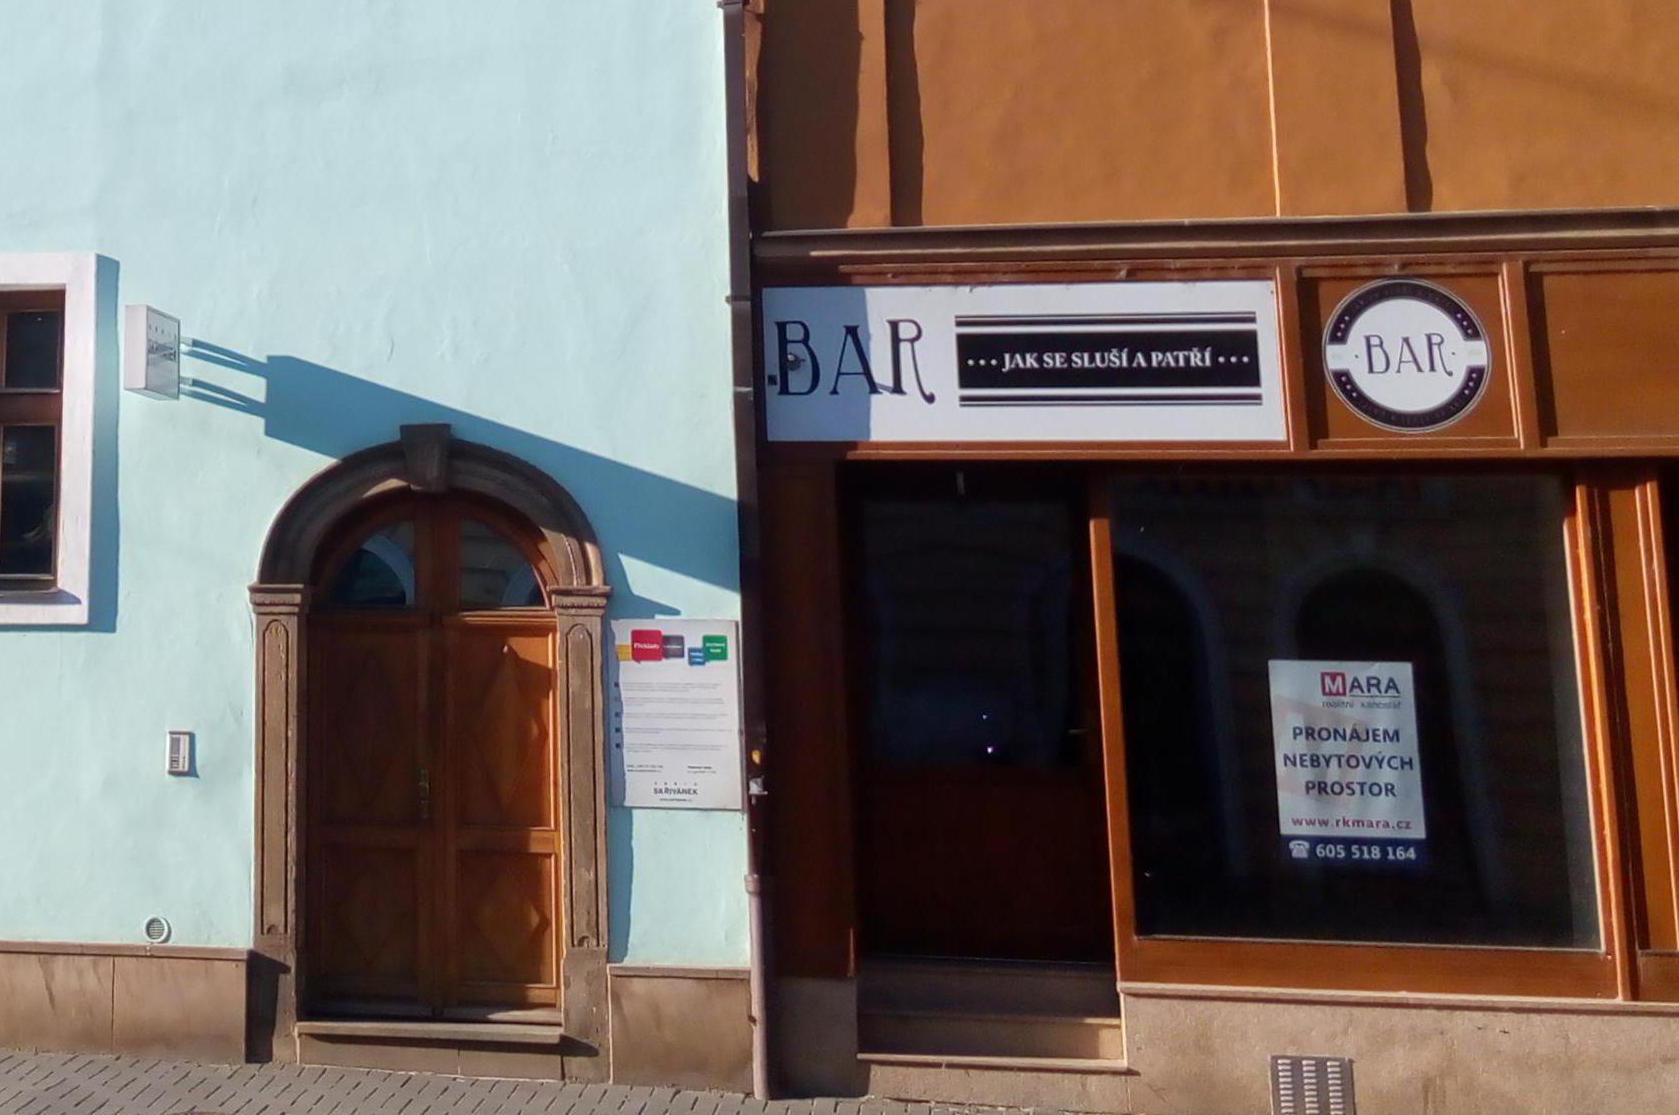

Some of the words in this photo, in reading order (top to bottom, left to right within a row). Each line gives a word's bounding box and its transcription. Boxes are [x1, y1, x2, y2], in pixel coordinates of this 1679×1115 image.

[774, 319, 936, 405] BAR
[1002, 351, 1039, 372] JAK
[1042, 352, 1068, 368] SE
[1071, 348, 1128, 368] SLUŠÍ
[1132, 351, 1147, 367] A
[1151, 347, 1212, 368] PATŘÍ
[1363, 333, 1453, 377] BAR
[1321, 673, 1401, 695] MARA
[1292, 723, 1401, 743] PRONÁJEM
[1283, 751, 1414, 771] NEBYTOVÝCH
[1305, 780, 1397, 797] PROSTOR
[1291, 815, 1413, 830] www.rkmara.cz
[1315, 844, 1346, 858] 605
[1351, 845, 1380, 859] 518
[1386, 846, 1417, 861] 164
